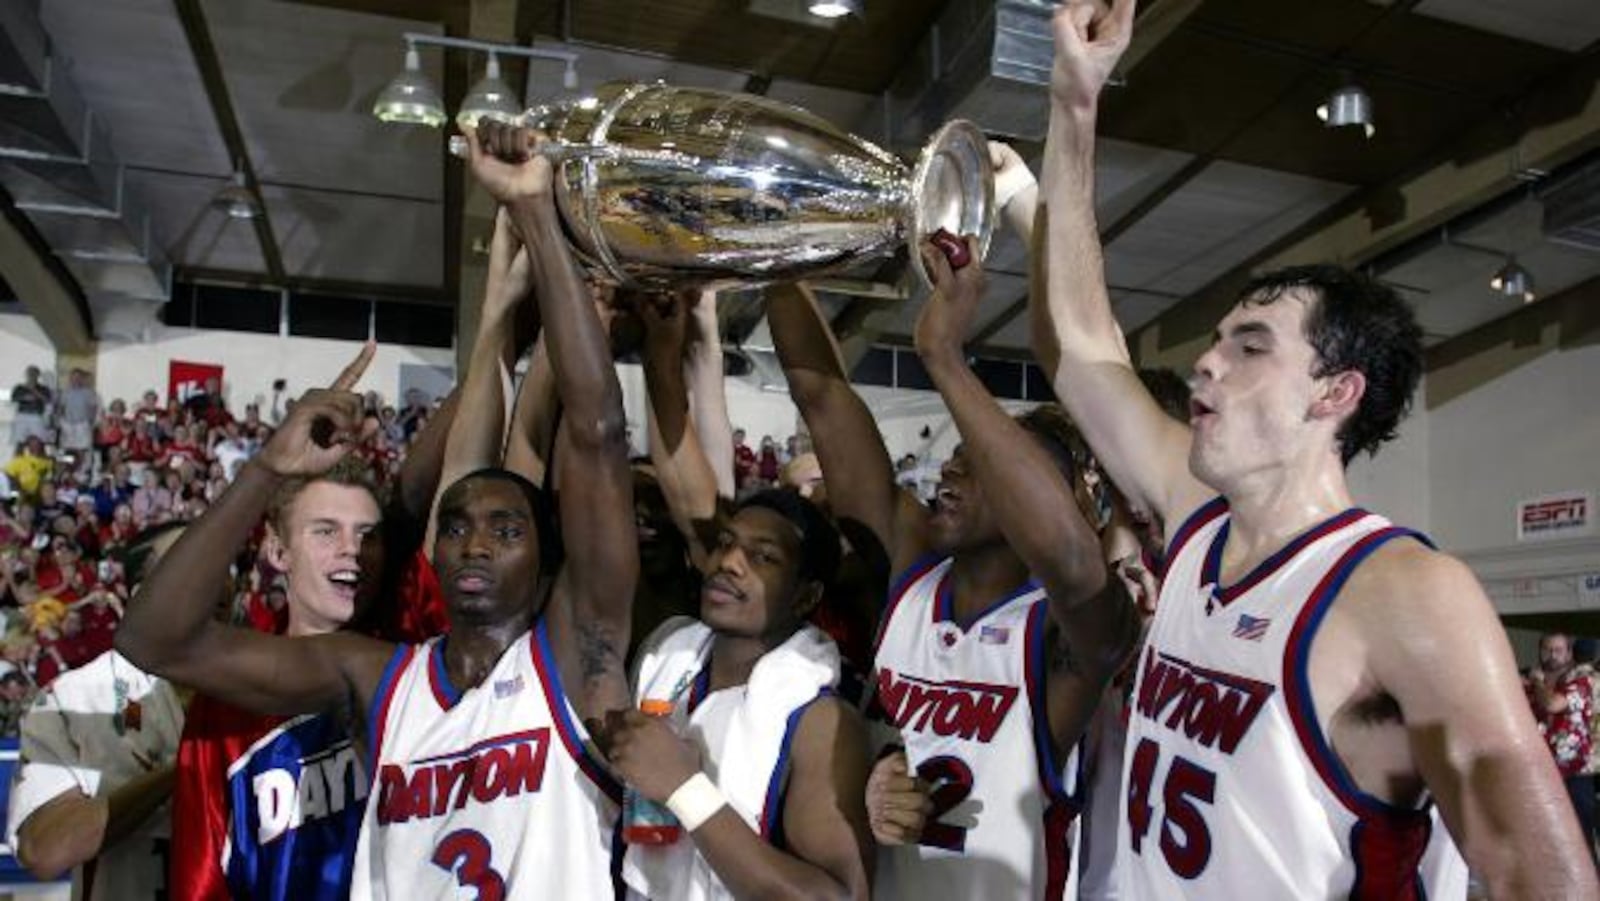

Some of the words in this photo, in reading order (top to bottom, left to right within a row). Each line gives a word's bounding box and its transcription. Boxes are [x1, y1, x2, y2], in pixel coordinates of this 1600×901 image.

[1523, 498, 1585, 522] ESPN
[377, 727, 550, 825] DAYTON
[915, 755, 973, 853] 2
[1127, 737, 1217, 879] 45
[431, 828, 506, 901] 3
